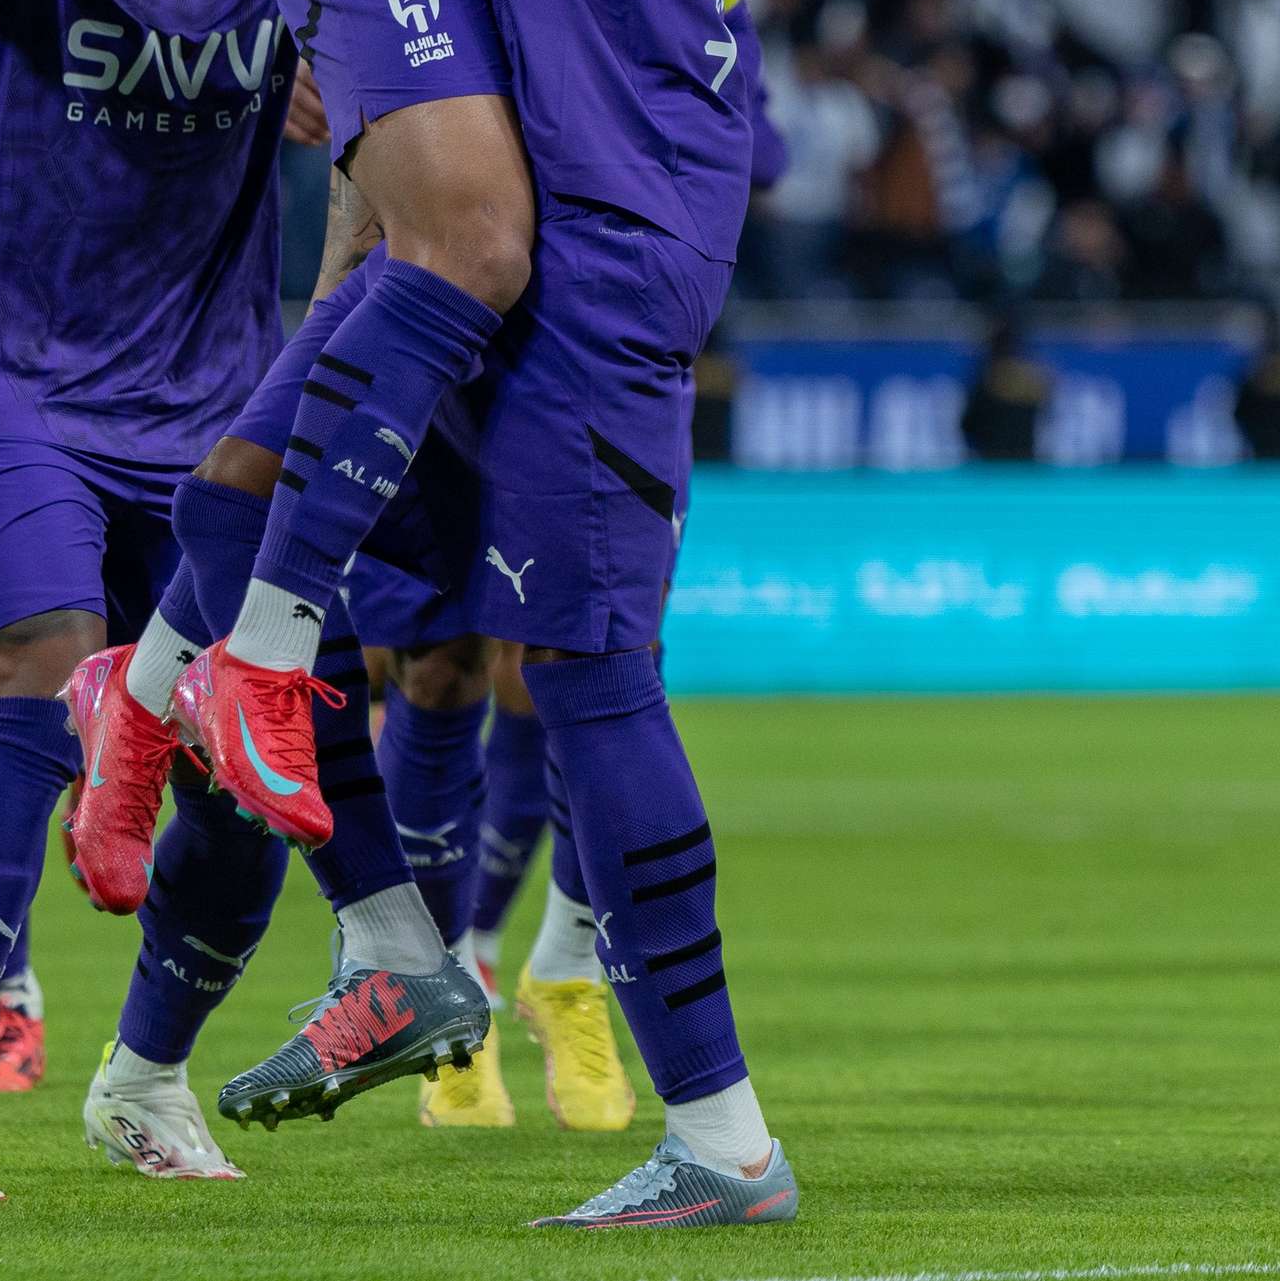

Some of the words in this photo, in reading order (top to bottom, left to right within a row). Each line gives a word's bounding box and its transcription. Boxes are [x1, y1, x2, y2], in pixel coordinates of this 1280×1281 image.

[404, 32, 454, 56] ALHILAL
[66, 102, 197, 133] GAMES
[332, 459, 366, 485] AL
